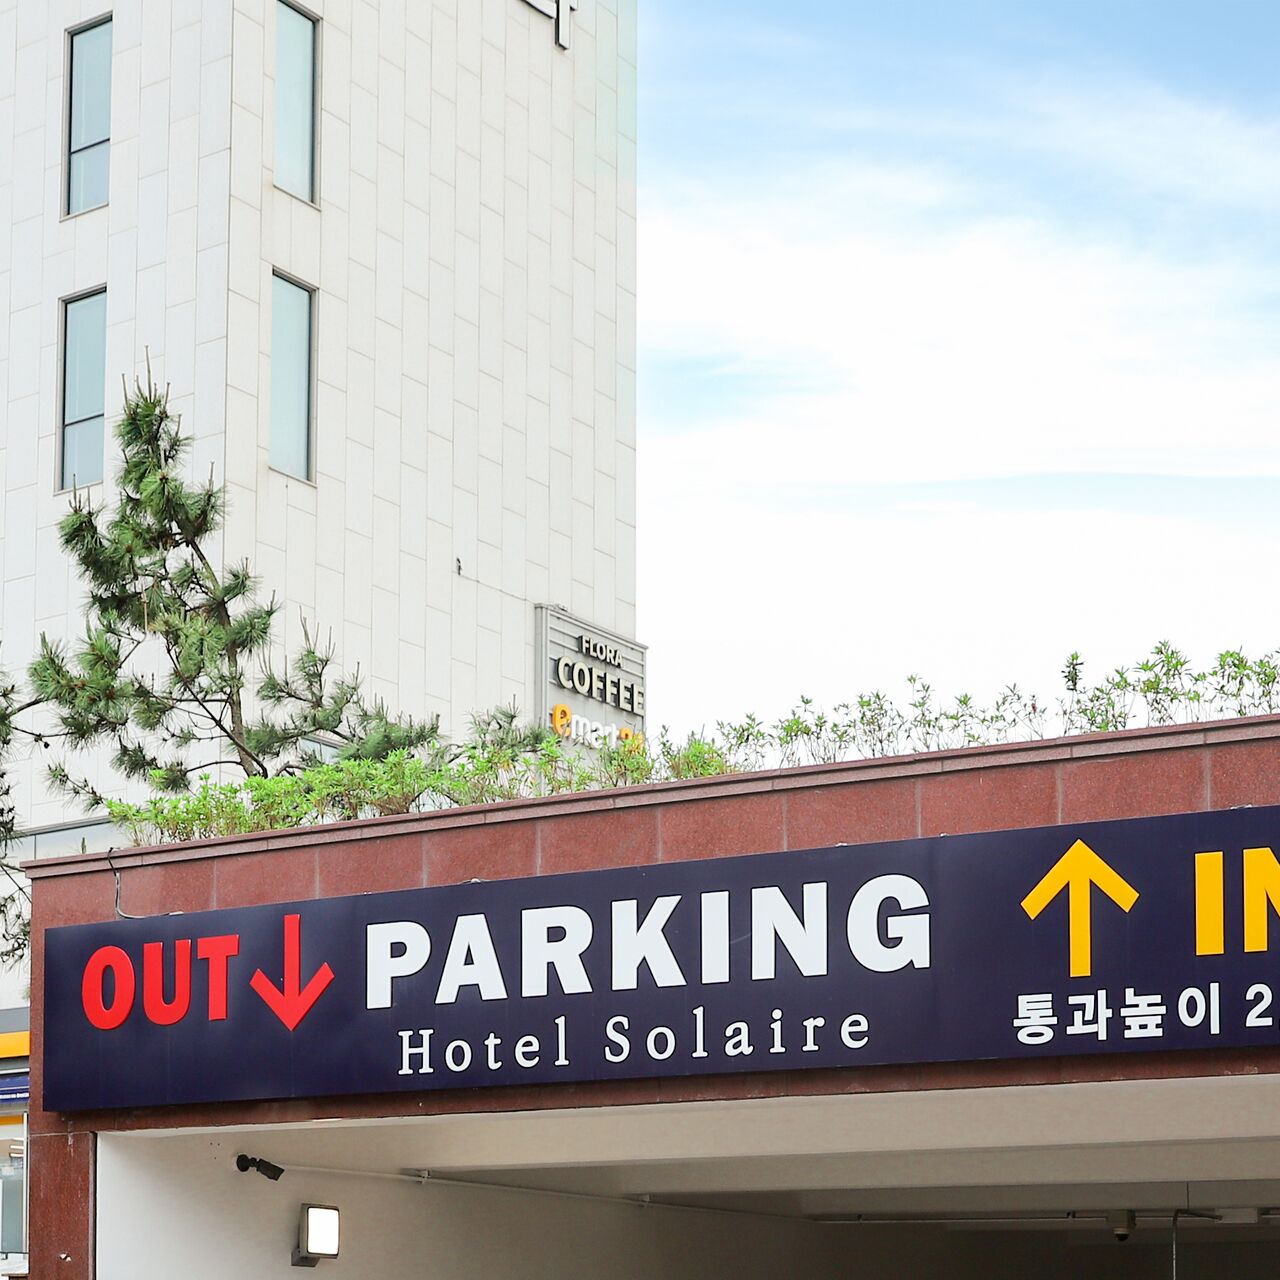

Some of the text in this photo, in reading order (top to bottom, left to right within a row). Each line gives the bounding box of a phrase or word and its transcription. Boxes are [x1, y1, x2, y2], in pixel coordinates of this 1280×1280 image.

[557, 656, 645, 716] COFFEE
[581, 635, 624, 668] FLORA
[365, 873, 932, 1011] PARKING
[81, 934, 240, 1031] OUT
[1012, 980, 1220, 1046] 통과높이
[396, 1005, 871, 1077] Hotel Solaire
